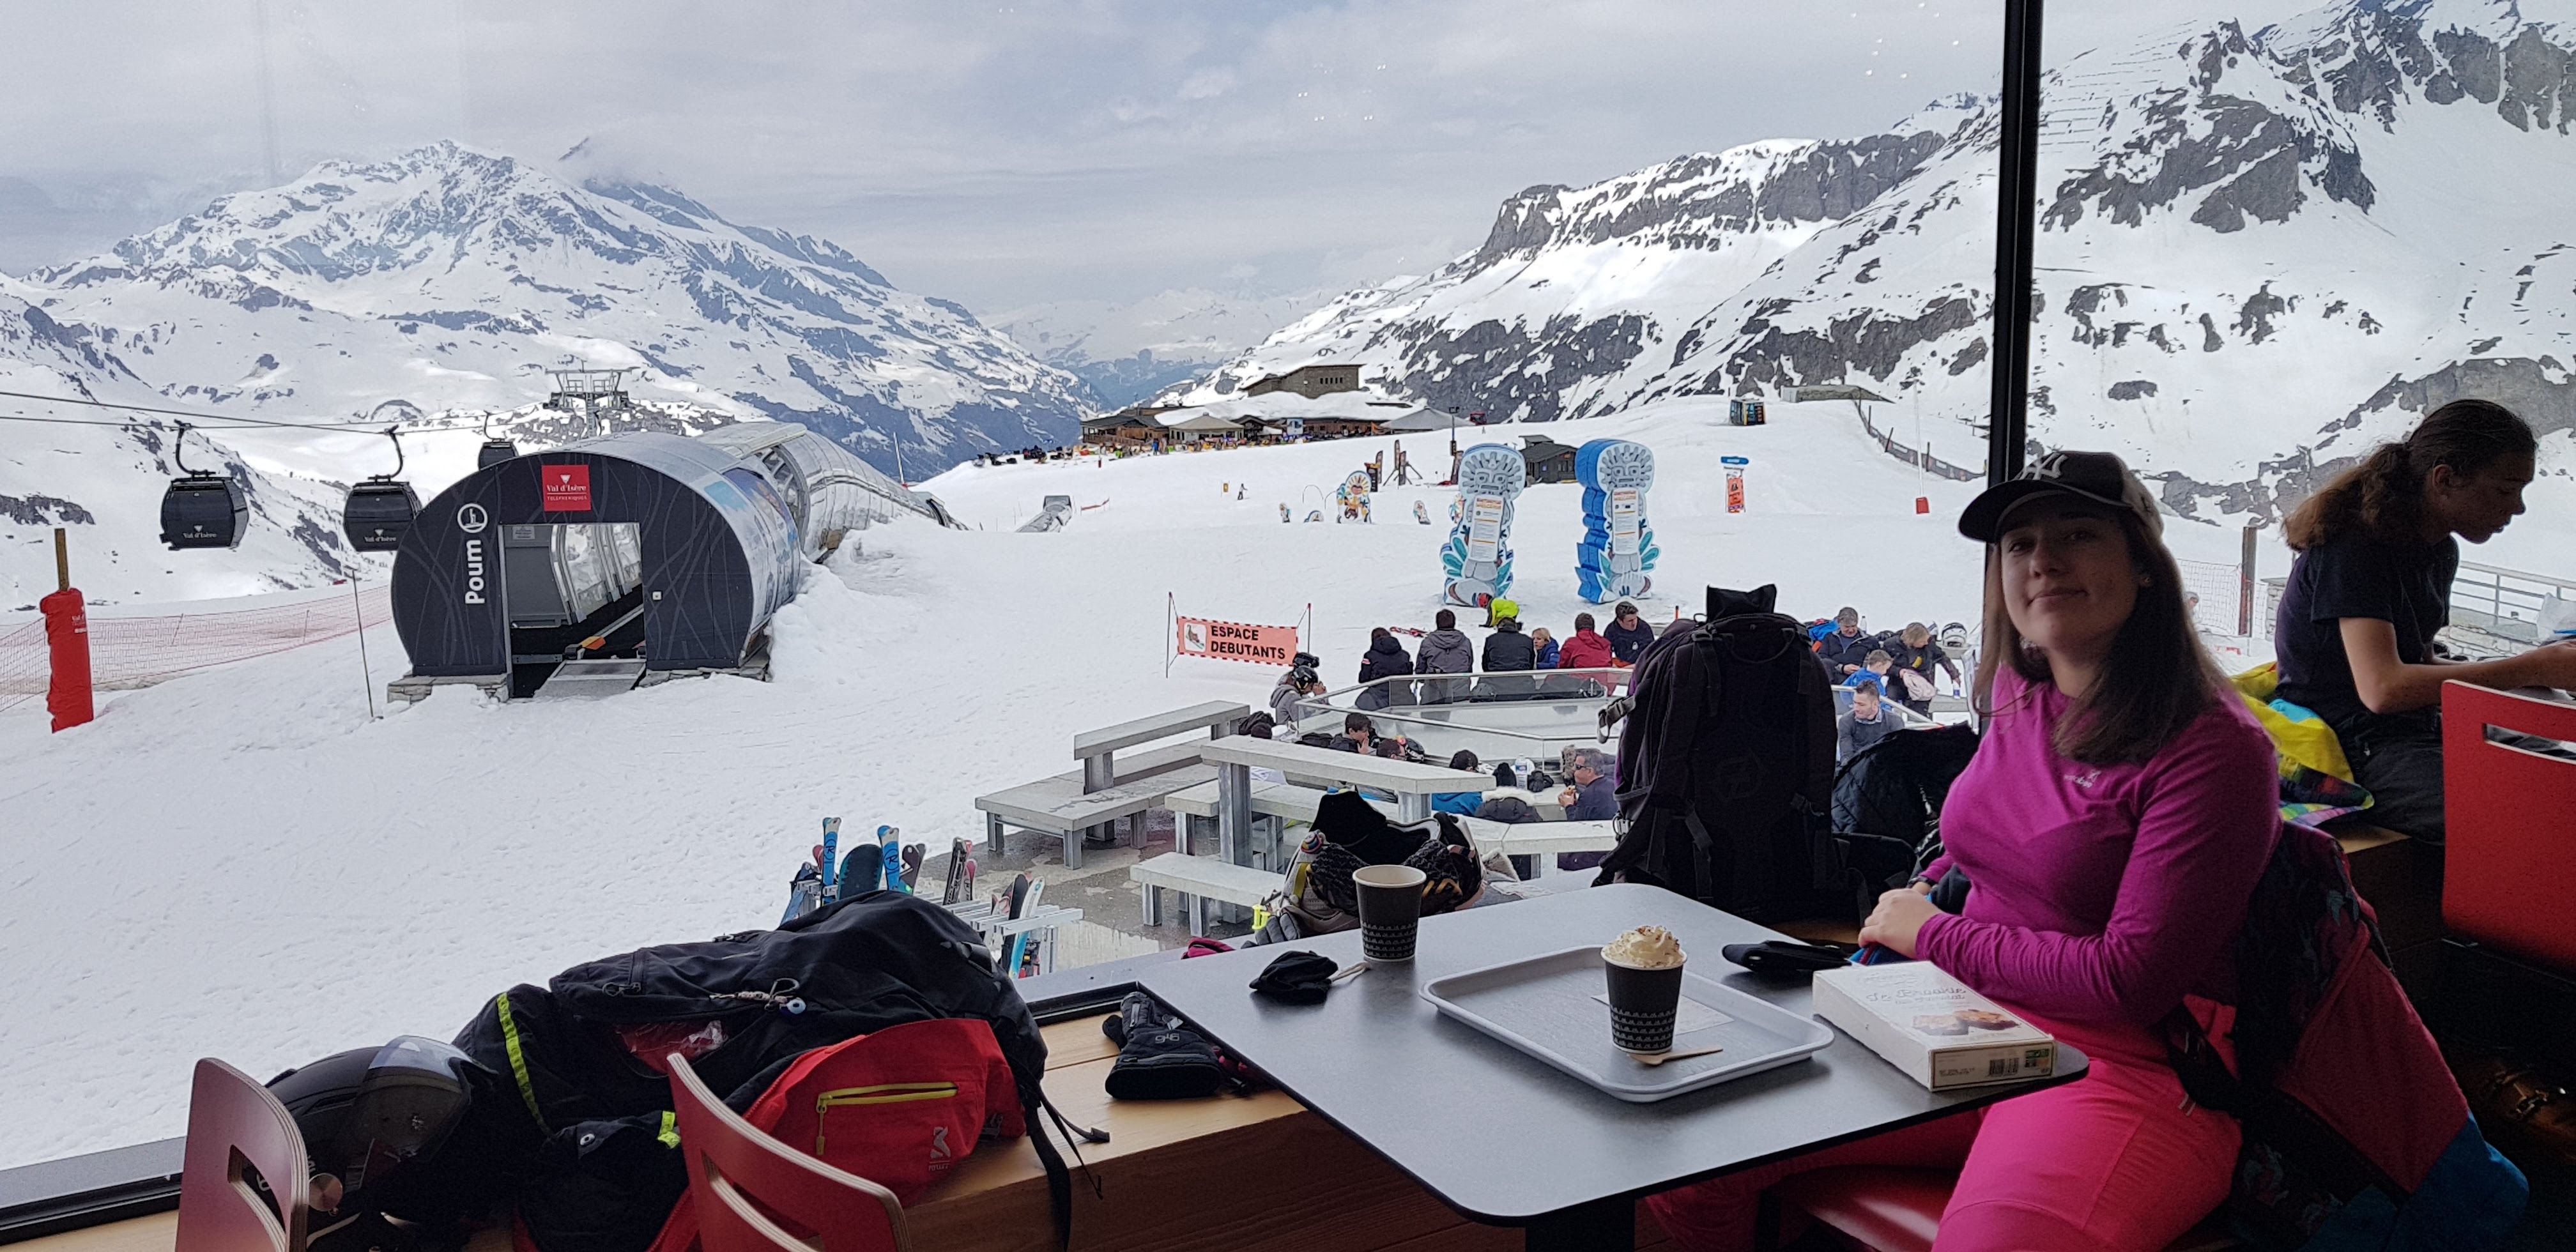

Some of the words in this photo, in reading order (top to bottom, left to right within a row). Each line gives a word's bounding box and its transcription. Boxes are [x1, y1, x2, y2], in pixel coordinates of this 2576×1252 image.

[464, 539, 486, 604] Poum
[1210, 625, 1259, 641] ESPACE
[1211, 640, 1285, 660] DEBUTANTS
